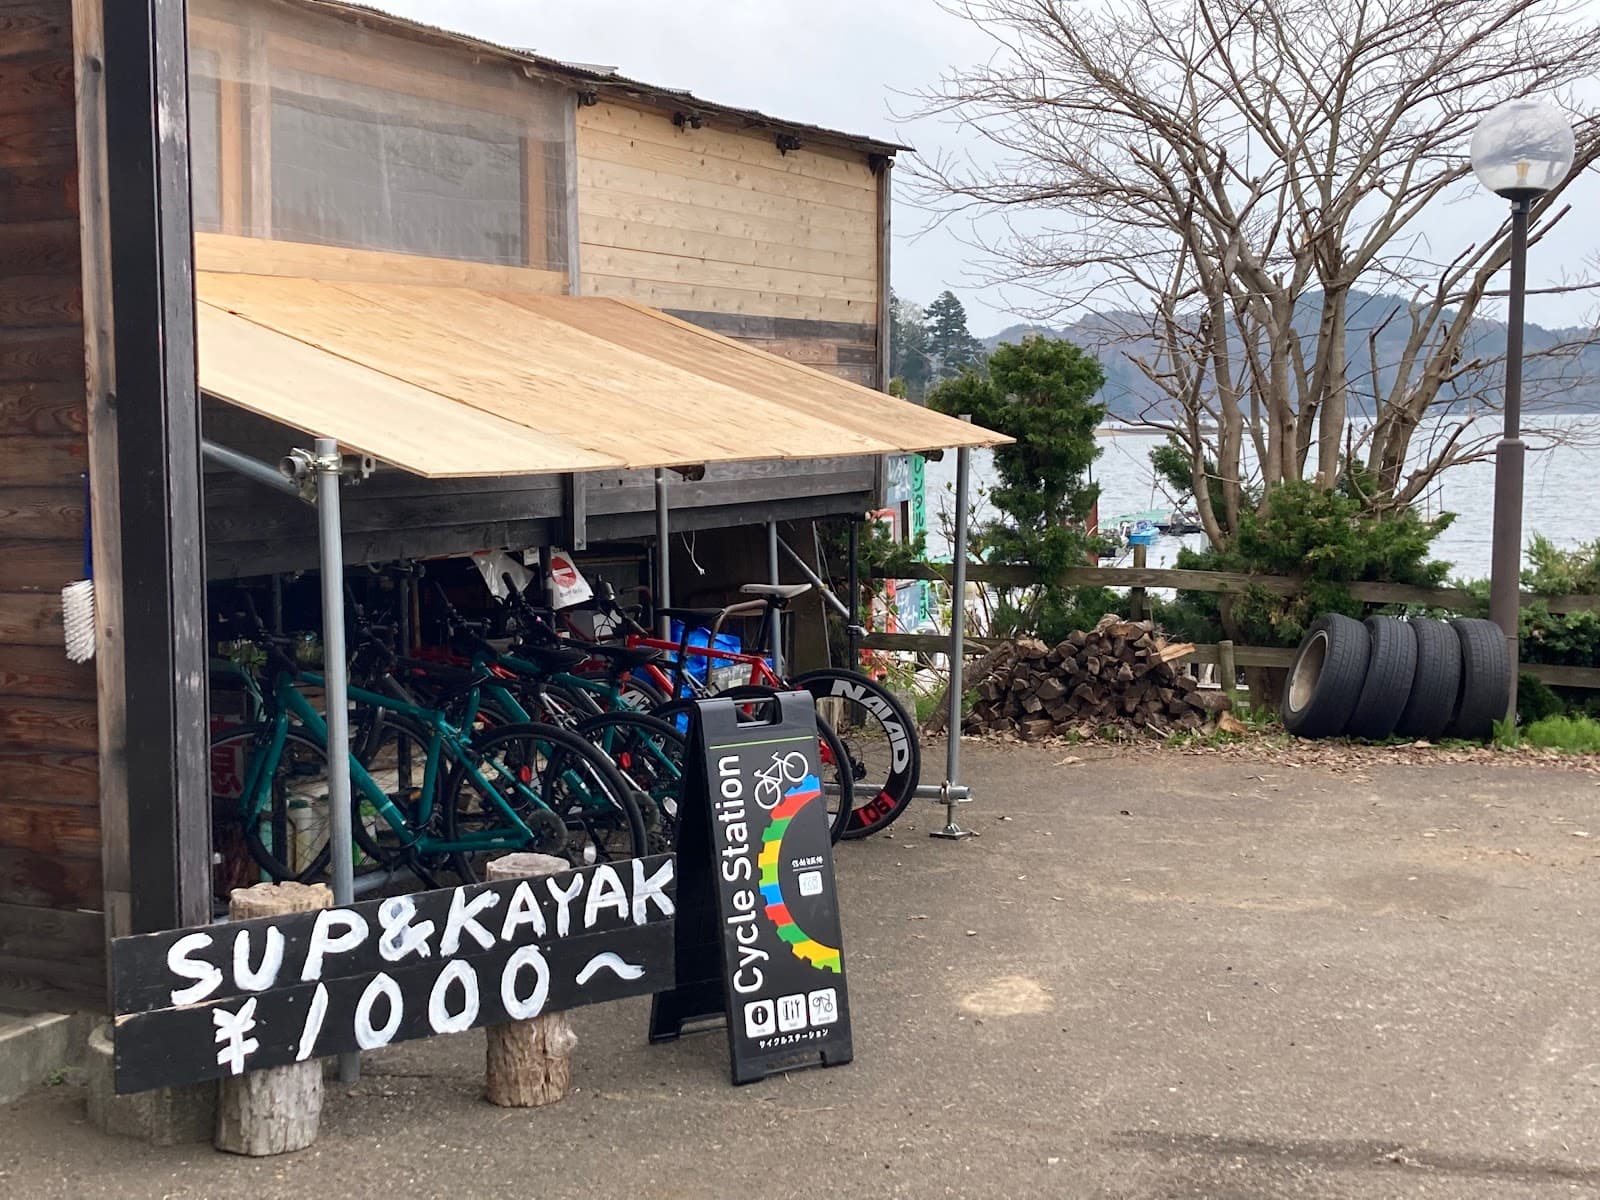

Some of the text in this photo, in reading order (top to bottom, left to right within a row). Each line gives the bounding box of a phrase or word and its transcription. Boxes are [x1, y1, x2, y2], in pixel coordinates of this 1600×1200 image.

[830, 679, 910, 775] NAIAD
[715, 755, 769, 994] Cycle Station
